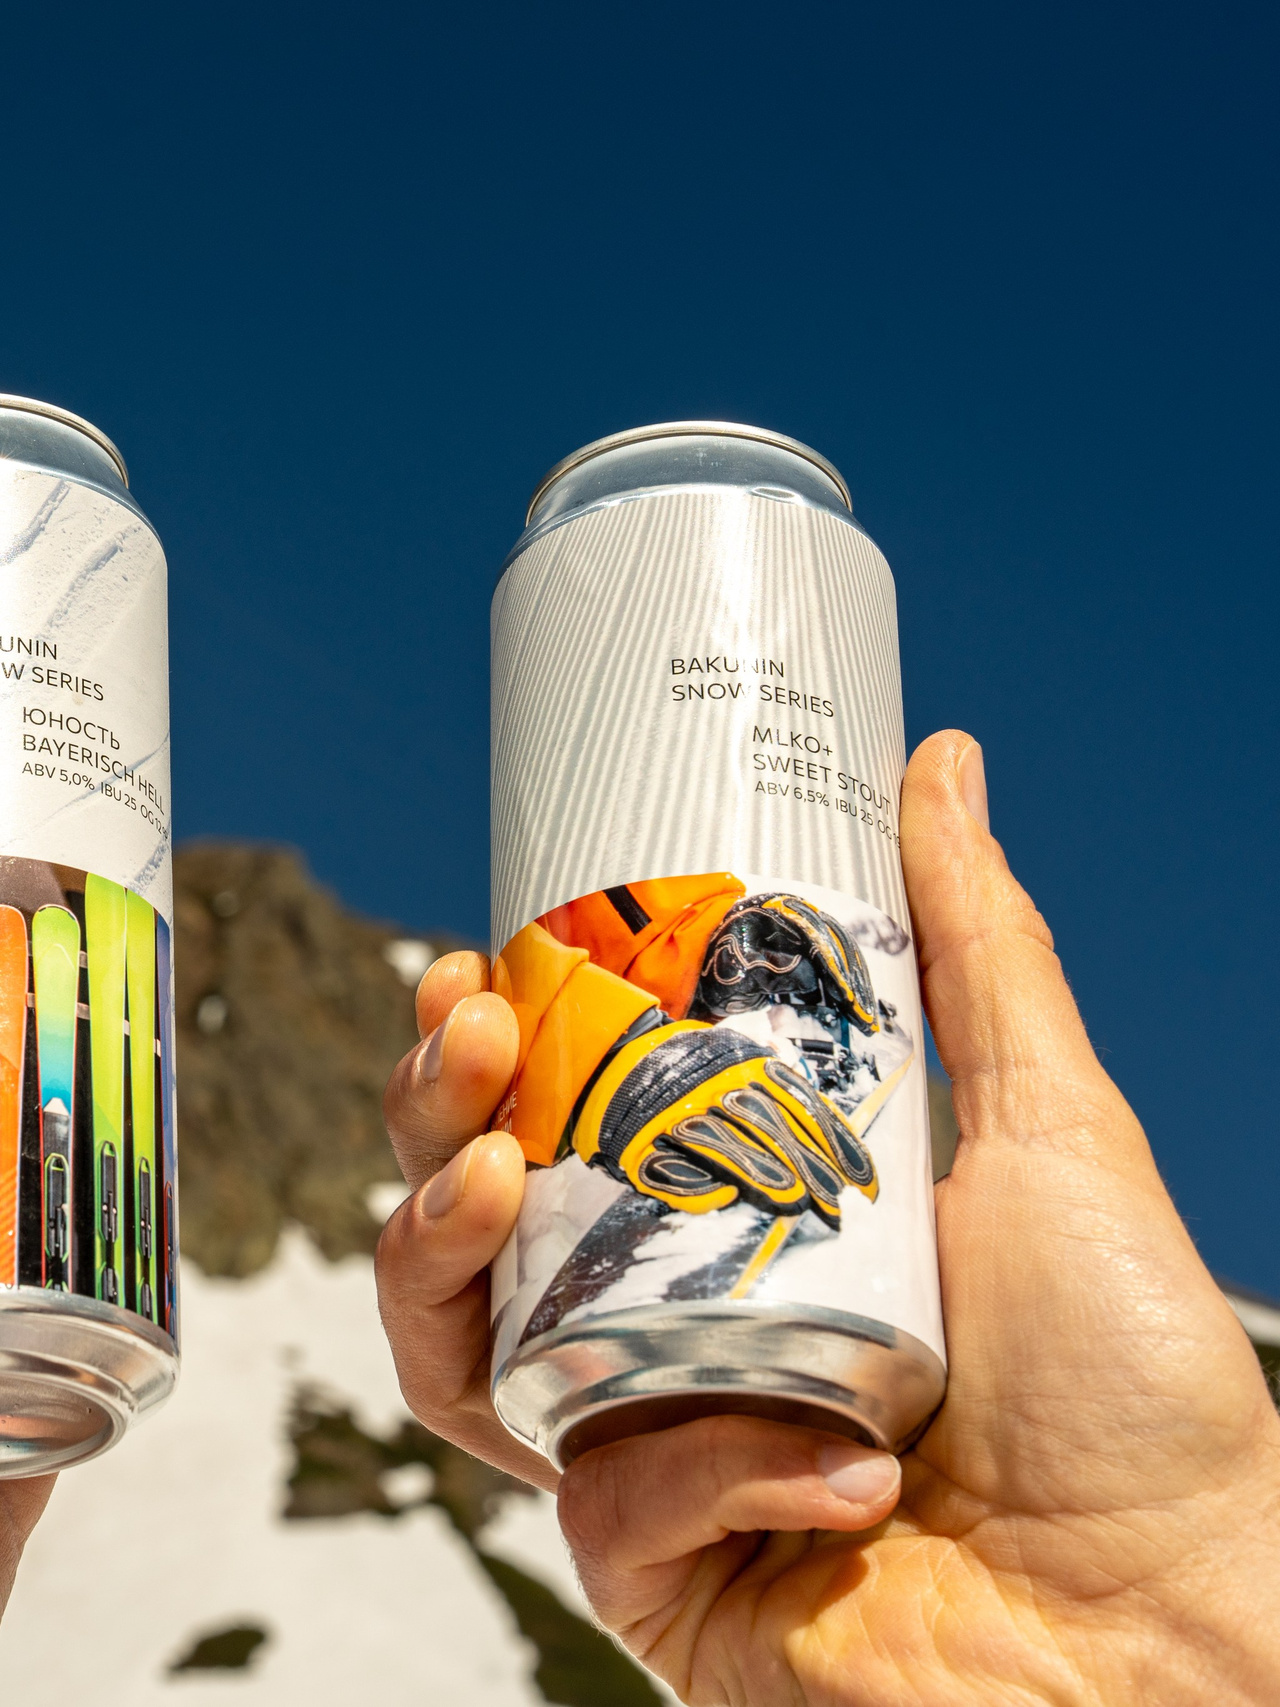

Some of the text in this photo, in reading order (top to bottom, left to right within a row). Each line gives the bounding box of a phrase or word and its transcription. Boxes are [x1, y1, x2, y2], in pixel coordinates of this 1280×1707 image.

[31, 666, 104, 701] SERIES
[671, 656, 785, 678] BAKUNIN
[671, 682, 835, 718] SNOW SERIES
[752, 725, 833, 757] MLKO+
[21, 761, 56, 779] ABV
[59, 769, 96, 791] 5,0%
[100, 781, 122, 802] IBU
[124, 793, 137, 811] 25
[140, 804, 154, 825] OG
[22, 734, 165, 816] BAYERISCH HELL
[752, 753, 891, 816] SWEET STOUT
[754, 780, 790, 798] ABV
[793, 787, 830, 807] 6,5%
[835, 797, 858, 817] IBU
[860, 808, 874, 826] 25
[877, 819, 892, 840] OG
